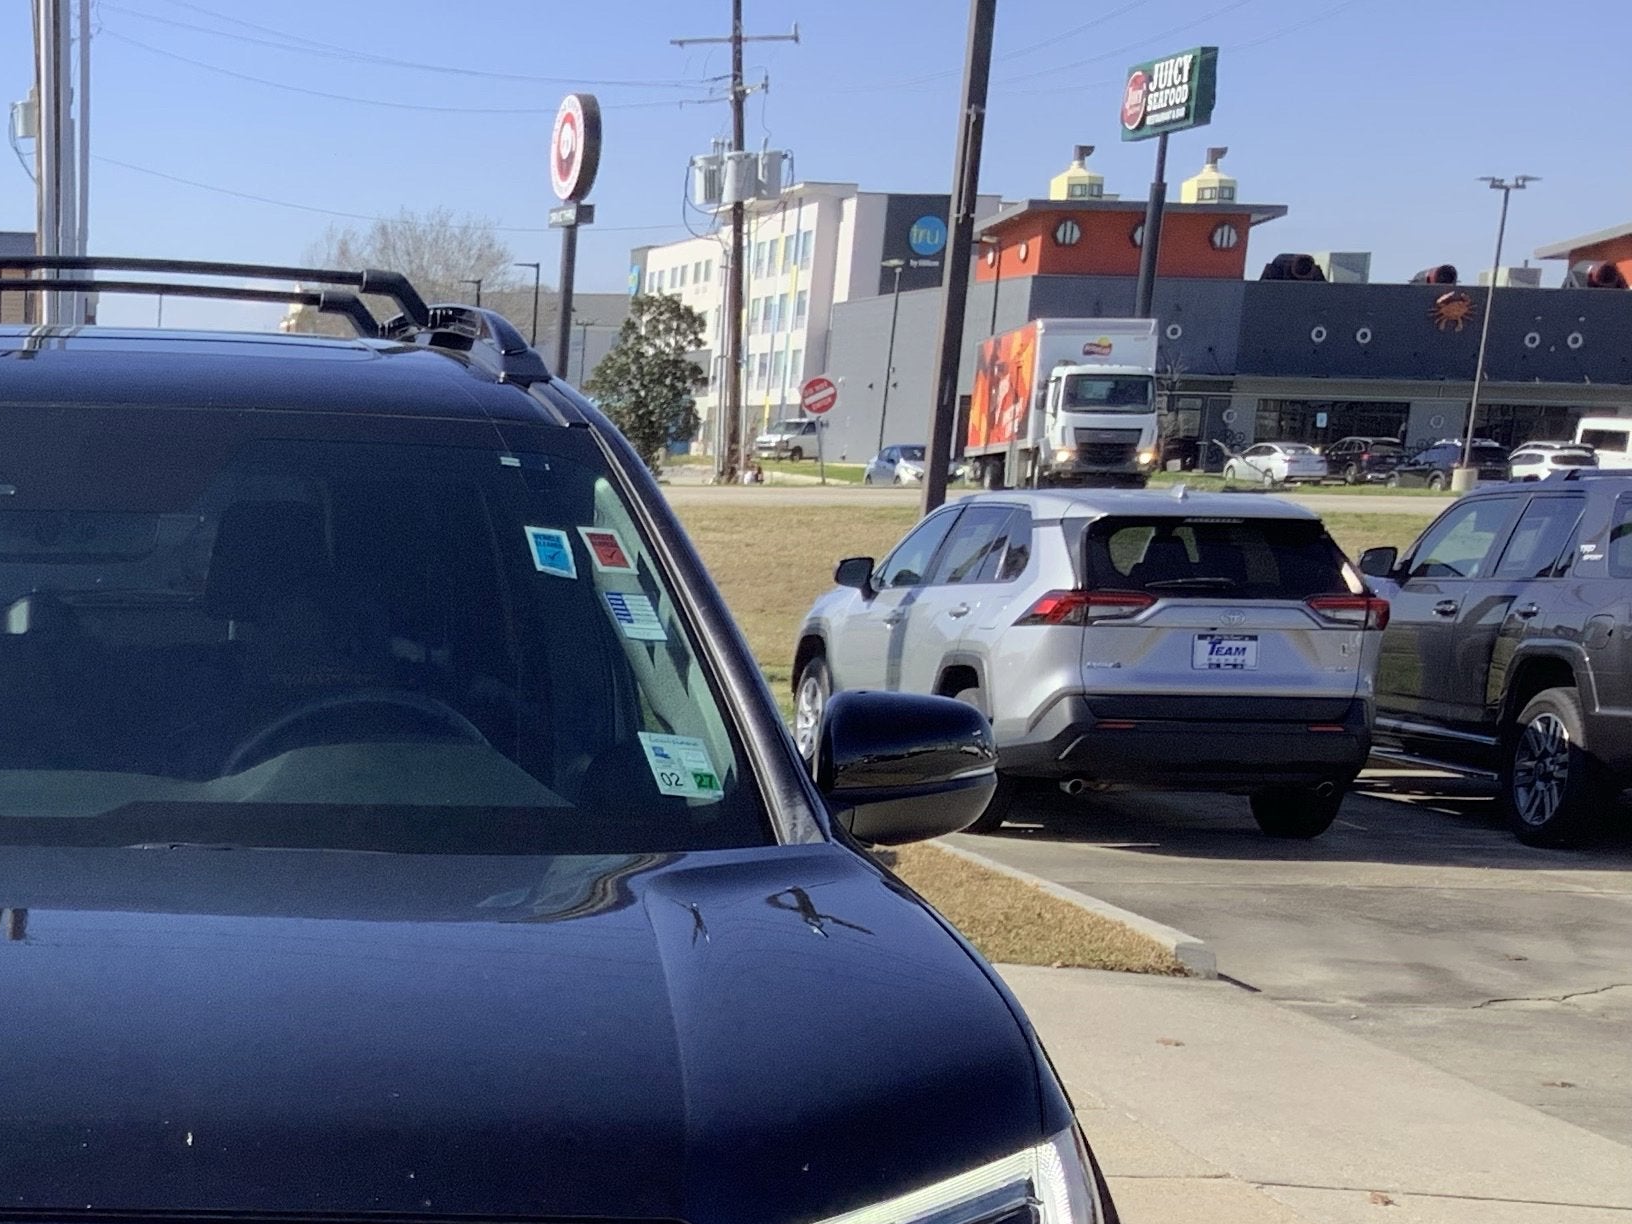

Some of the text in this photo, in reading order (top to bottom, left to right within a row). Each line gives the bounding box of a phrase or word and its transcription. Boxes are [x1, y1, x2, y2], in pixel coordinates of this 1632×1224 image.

[1149, 54, 1193, 92] JUICY
[1147, 84, 1189, 112] SEAFOOD
[1208, 639, 1247, 656] TEAM
[660, 772, 714, 789] 02 27
